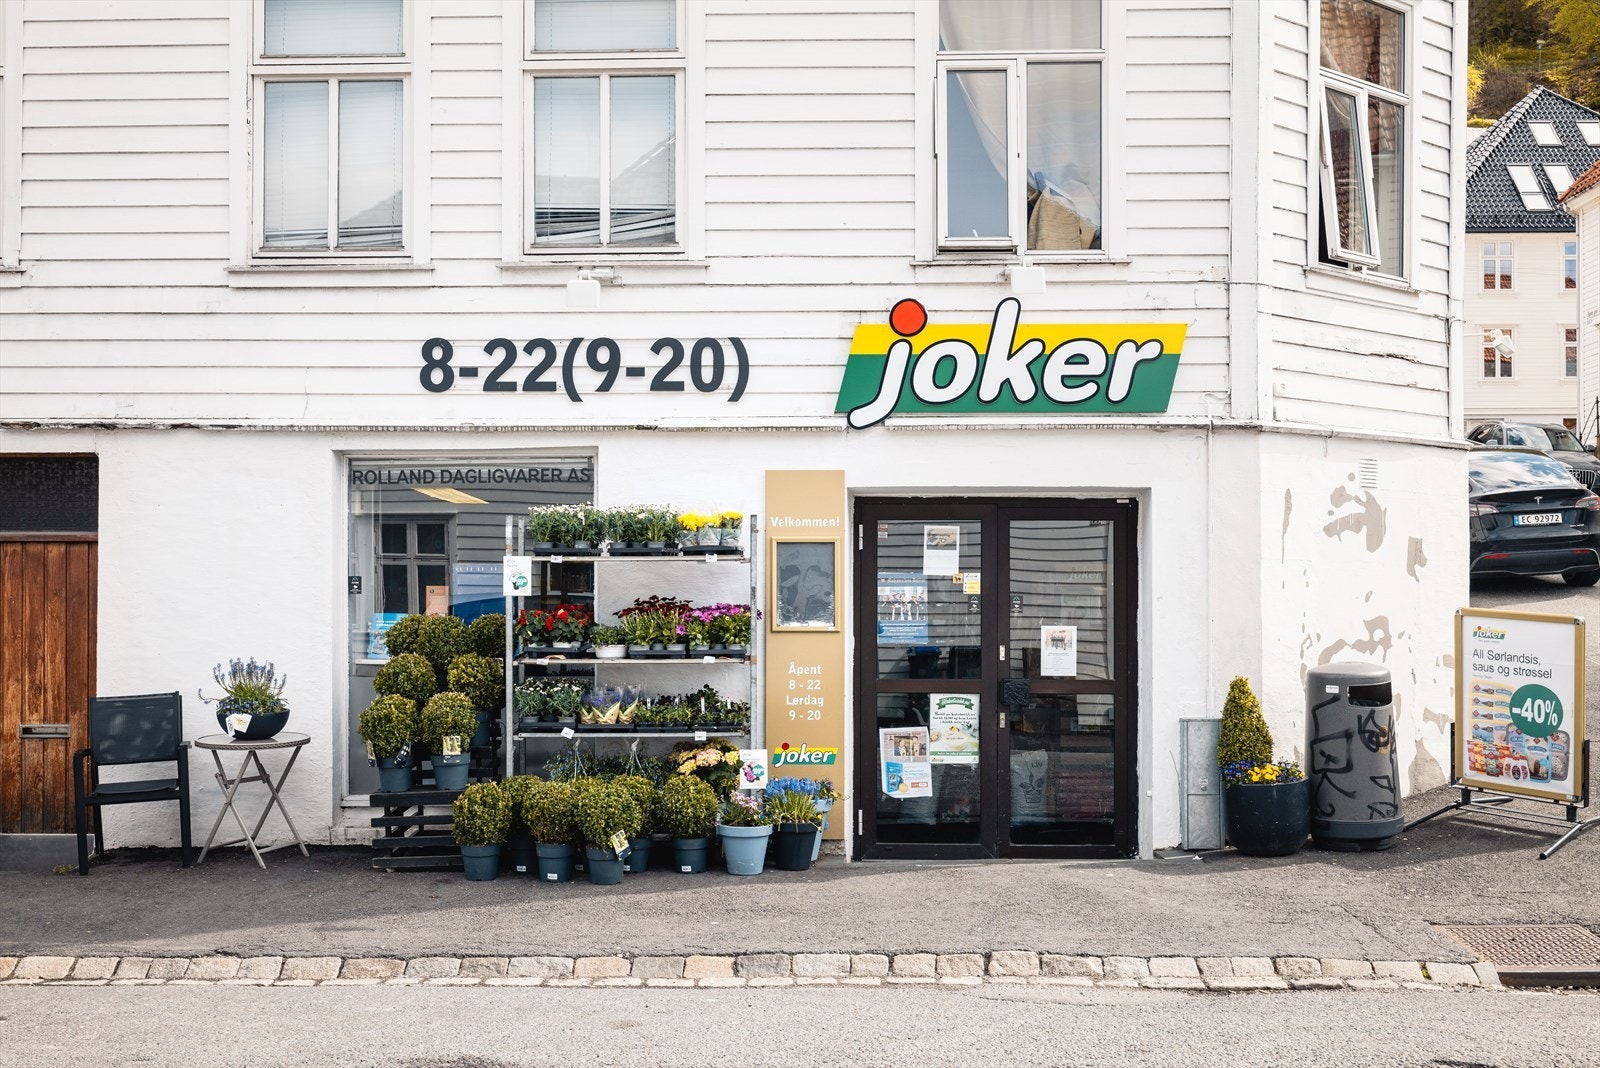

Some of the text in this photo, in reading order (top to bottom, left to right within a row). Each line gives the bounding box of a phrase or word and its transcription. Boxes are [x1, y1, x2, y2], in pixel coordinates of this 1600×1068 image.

[419, 337, 750, 402] 8-22(9-20)
[847, 297, 1164, 430] joker
[352, 467, 592, 485] ROLLAND DAGLIGVARER AS
[770, 516, 840, 527] Velkommen!
[1521, 515, 1532, 524] EC
[1534, 514, 1560, 523] 92972
[1473, 625, 1504, 640] joker
[1472, 648, 1541, 666] All Sørlandsis,
[788, 661, 822, 676] Åpent
[1472, 662, 1495, 673] saus
[1497, 665, 1510, 677] og
[1513, 666, 1553, 679] strøssel
[789, 679, 796, 690] 8
[807, 679, 821, 690] 22
[786, 694, 824, 707] Lørdag
[788, 710, 796, 720] 9
[807, 710, 821, 720] 20
[1512, 697, 1558, 726] -40%
[774, 743, 833, 768] joker
